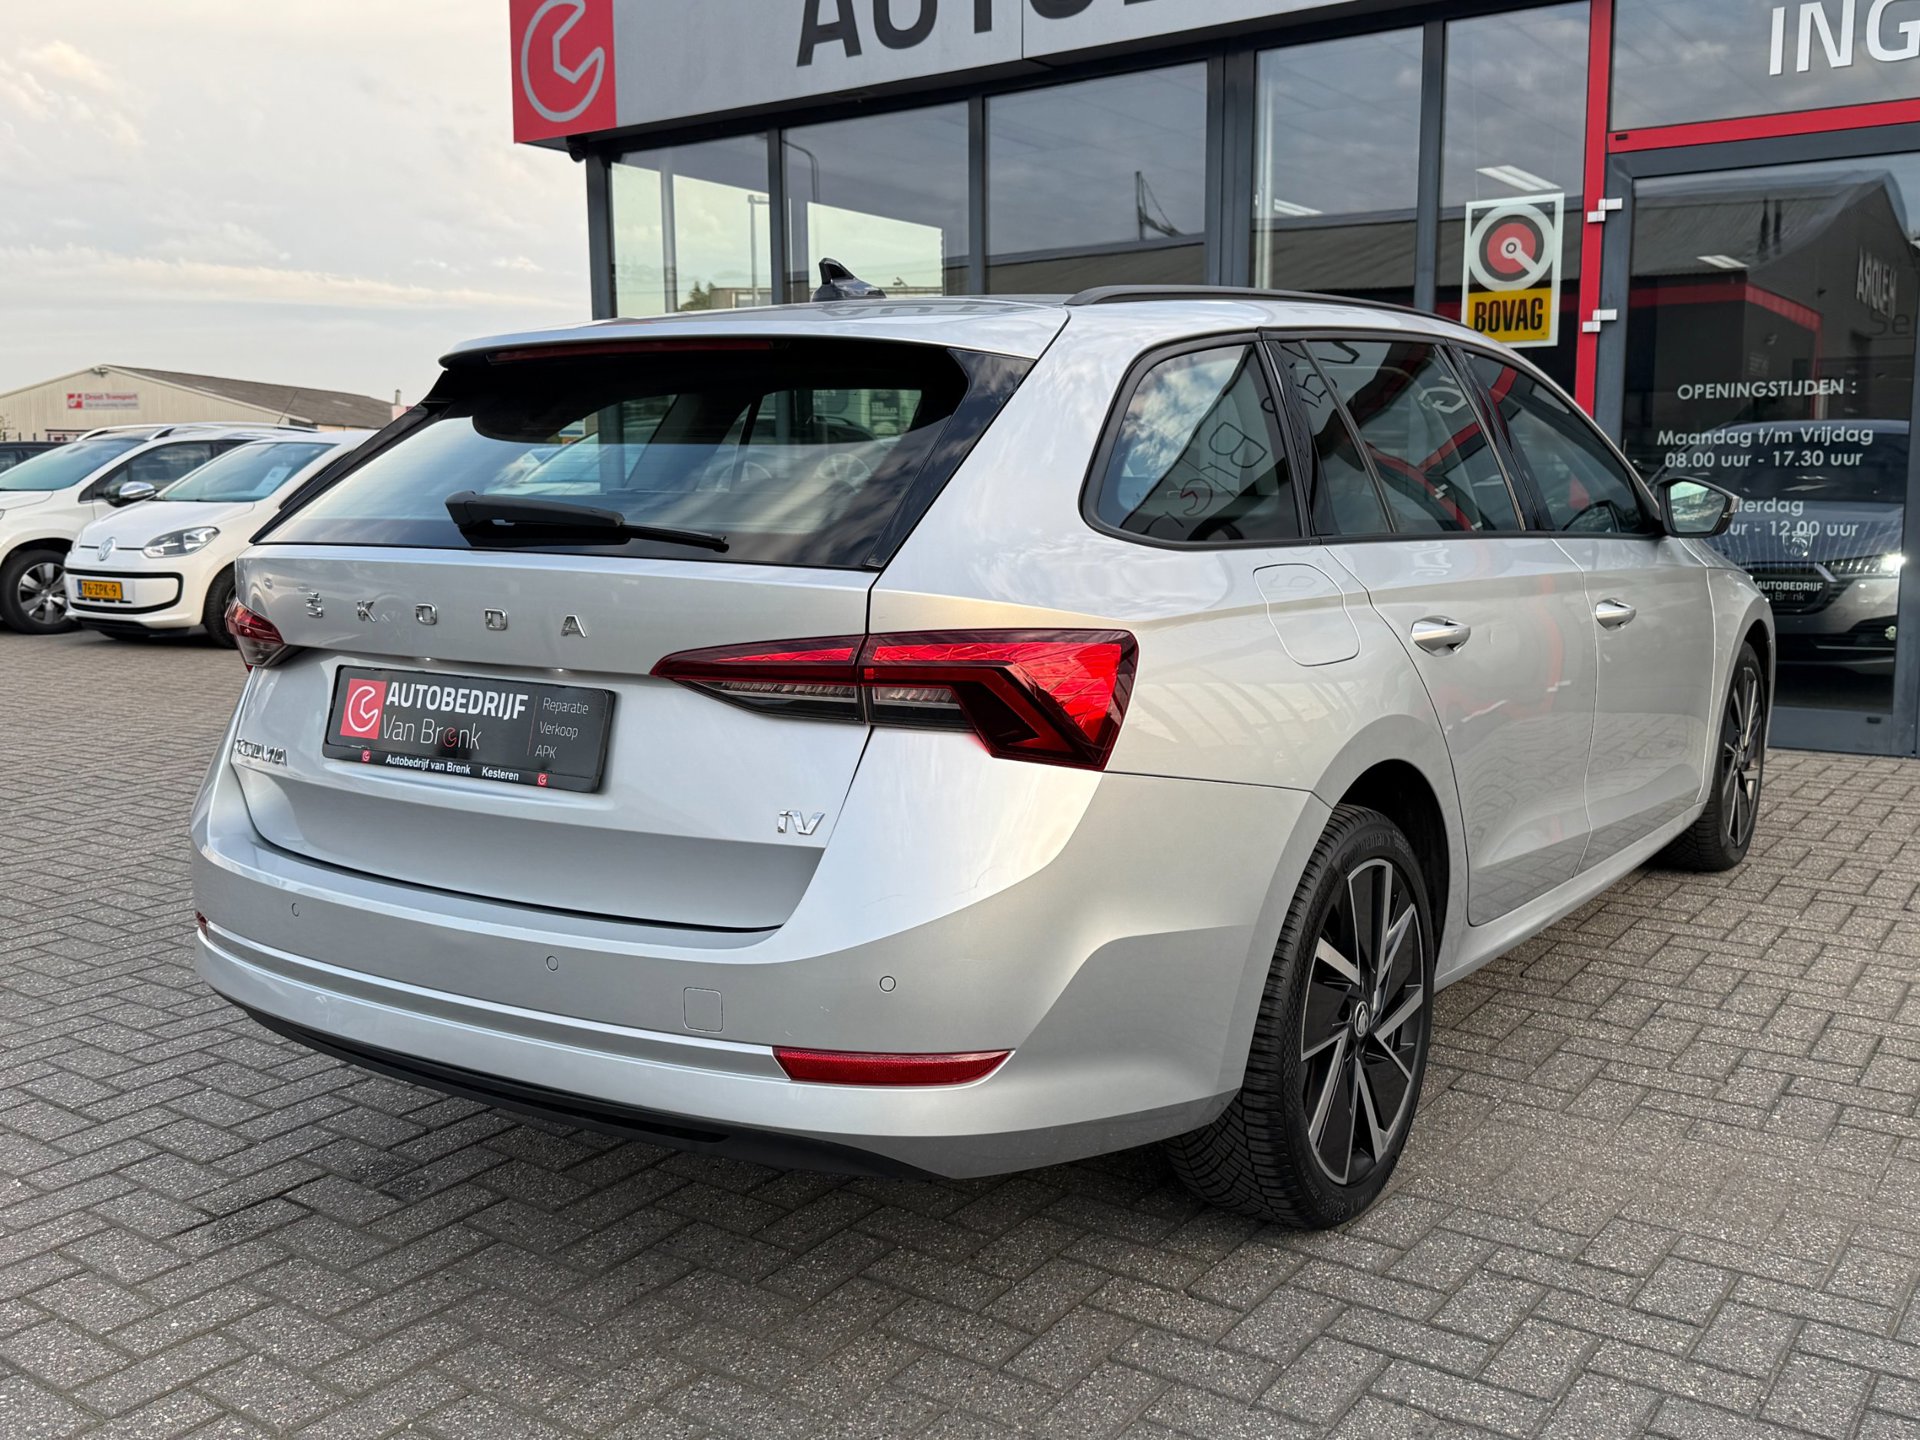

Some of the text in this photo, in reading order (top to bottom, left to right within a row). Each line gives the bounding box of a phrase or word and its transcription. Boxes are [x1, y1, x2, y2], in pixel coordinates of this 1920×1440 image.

[1474, 298, 1544, 333] BOVAG
[1677, 378, 1845, 400] OPENINGSTIJDEN
[1656, 425, 1874, 448] Maandag t/m Vrijdag
[1664, 451, 1715, 468] 08.00
[1721, 455, 1751, 467] uur
[1773, 450, 1824, 467] 17.30
[1830, 452, 1863, 466] uur
[1738, 497, 1804, 516] terdag
[1827, 523, 1859, 536] uur
[1756, 580, 1823, 592] AUTOBEDRIJF
[386, 681, 529, 721] AUTOBEDRIJF
[542, 697, 589, 715] Reparatie
[383, 714, 415, 742] Van
[539, 721, 579, 740] Verkoop
[534, 744, 558, 760] APK
[385, 754, 472, 775] Autobedrijf van Brenk
[481, 766, 519, 782] Kesteren
